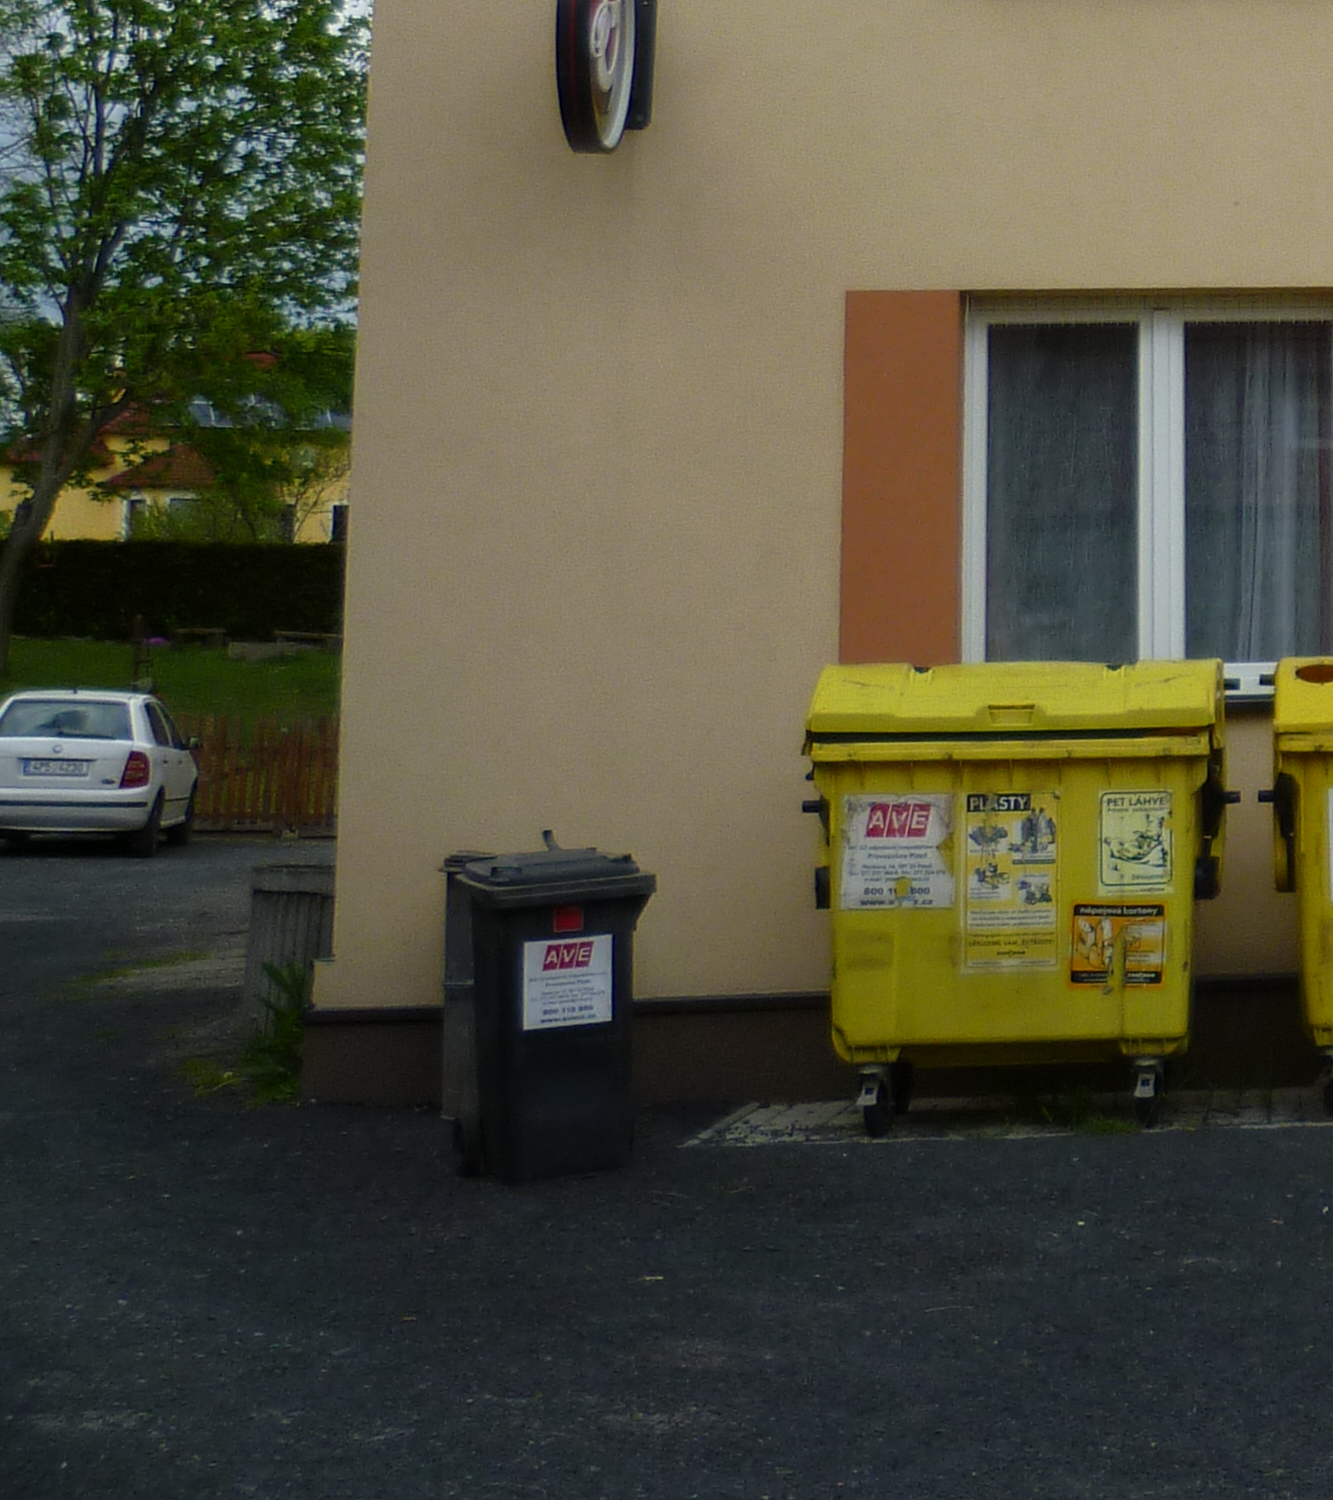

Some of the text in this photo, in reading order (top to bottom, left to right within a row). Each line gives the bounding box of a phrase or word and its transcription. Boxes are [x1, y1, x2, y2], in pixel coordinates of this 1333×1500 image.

[1106, 797, 1126, 807] PET
[867, 810, 930, 831] AVE
[545, 946, 591, 965] AVE
